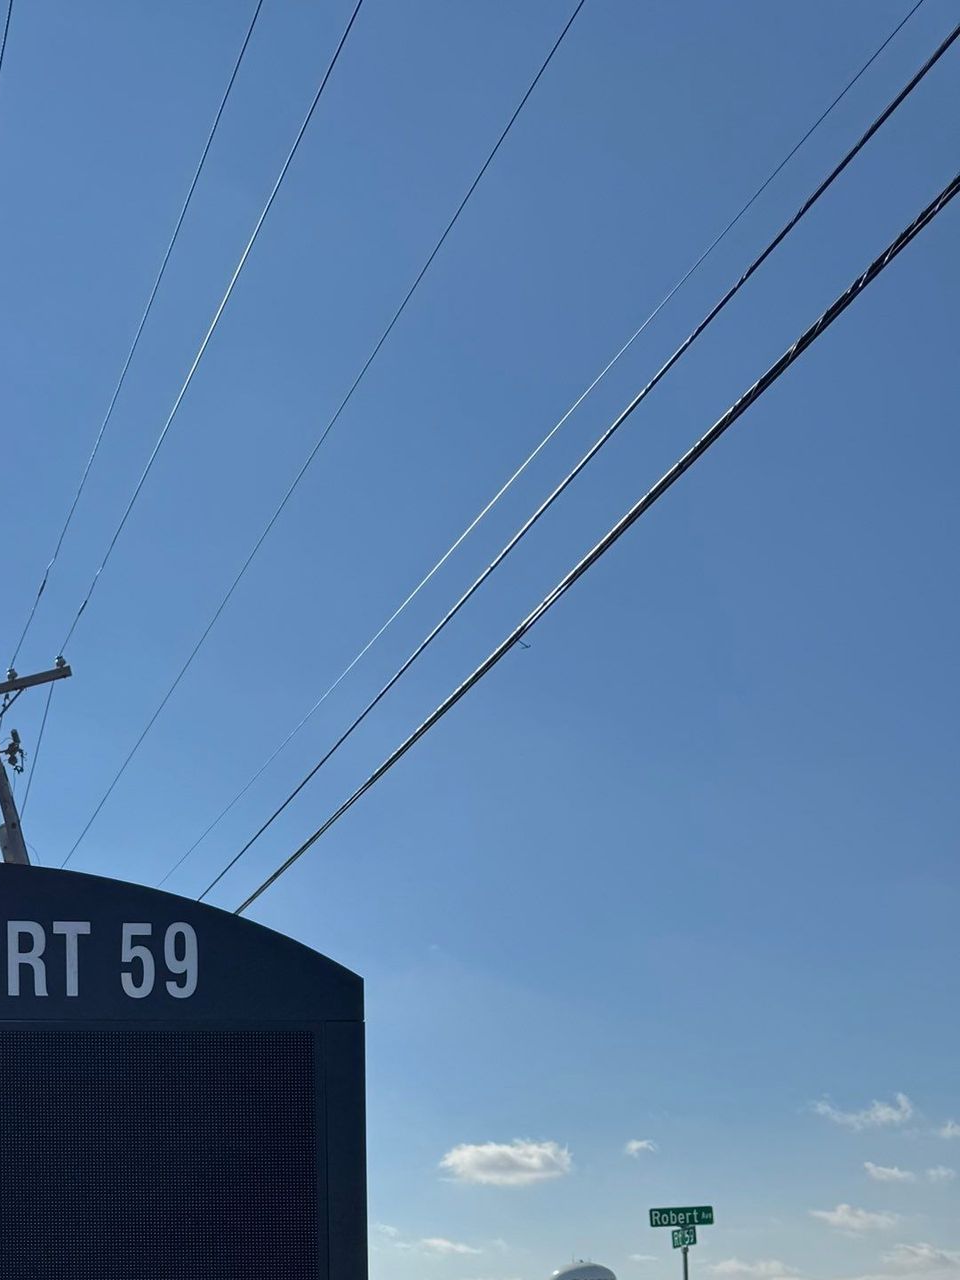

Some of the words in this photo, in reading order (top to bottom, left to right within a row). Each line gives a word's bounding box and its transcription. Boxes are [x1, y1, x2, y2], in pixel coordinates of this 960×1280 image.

[6, 919, 91, 997] RT
[120, 921, 199, 999] 59
[651, 1209, 699, 1225] Robert
[684, 1228, 695, 1245] 59
